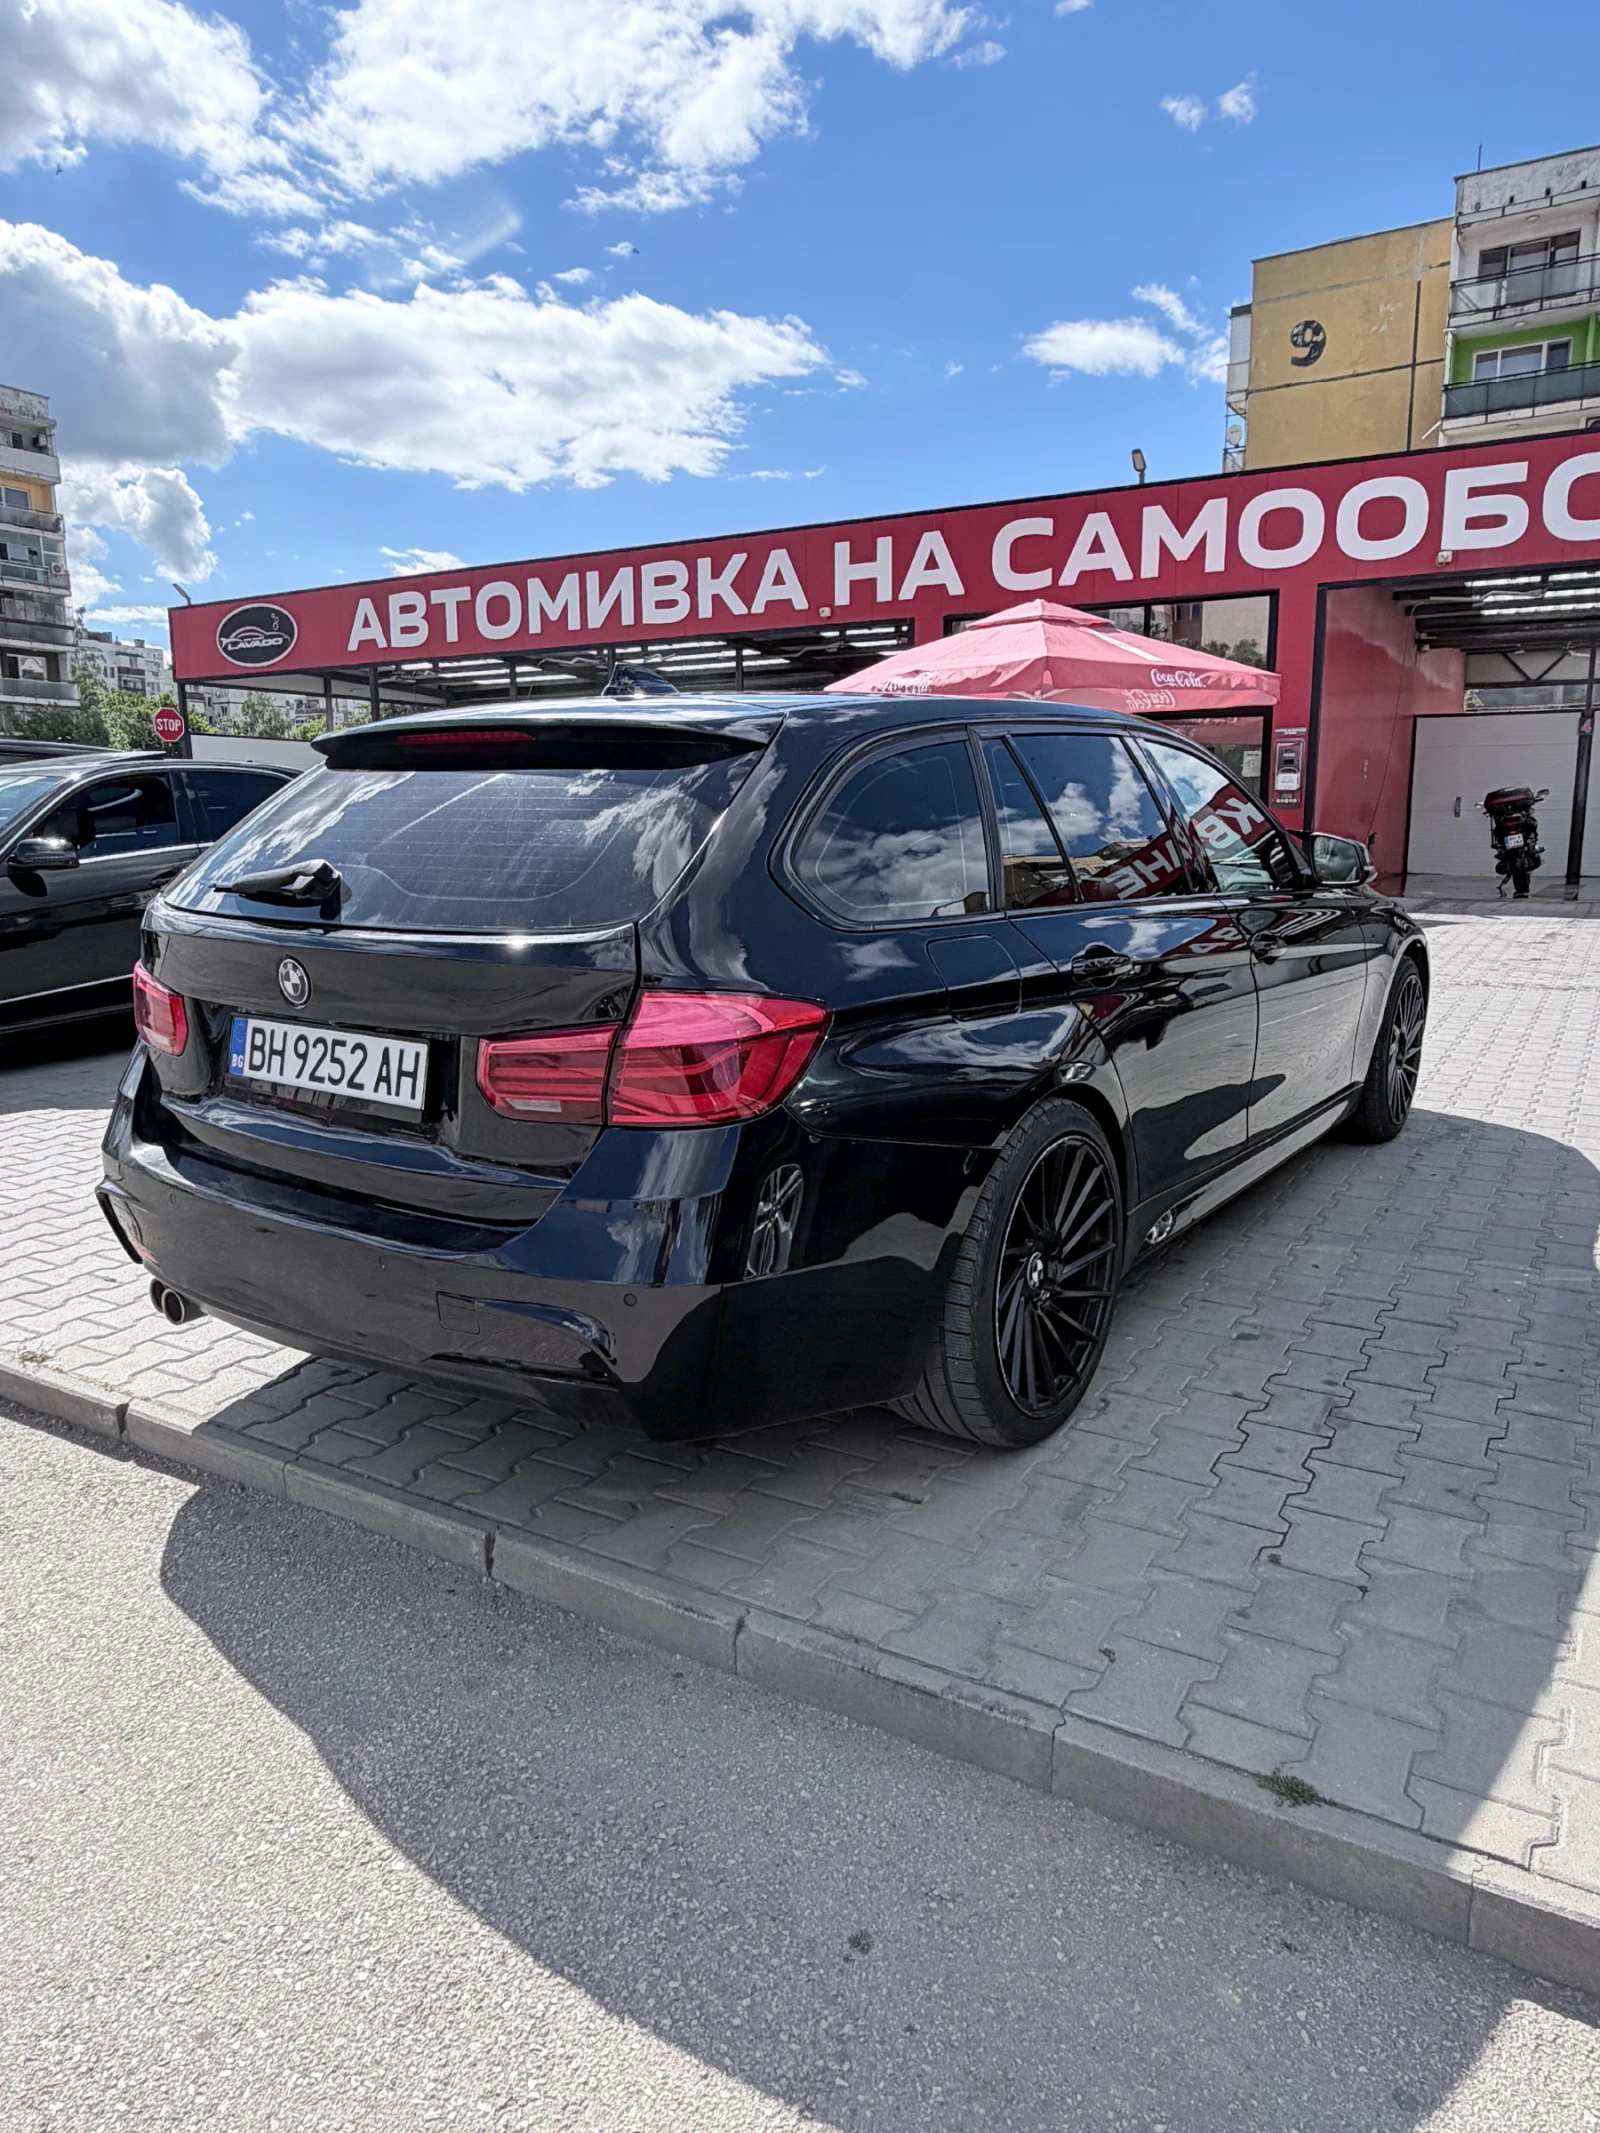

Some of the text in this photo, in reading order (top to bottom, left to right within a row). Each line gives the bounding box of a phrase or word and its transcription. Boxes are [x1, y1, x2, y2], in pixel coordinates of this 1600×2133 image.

[1290, 320, 1327, 367] 9
[347, 451, 1600, 651] АВТОМИВКА НА САМООБС
[227, 637, 283, 651] LAVADO
[156, 718, 182, 731] STOP
[231, 1053, 244, 1068] BG
[248, 1026, 420, 1100] BH 9252 AH
